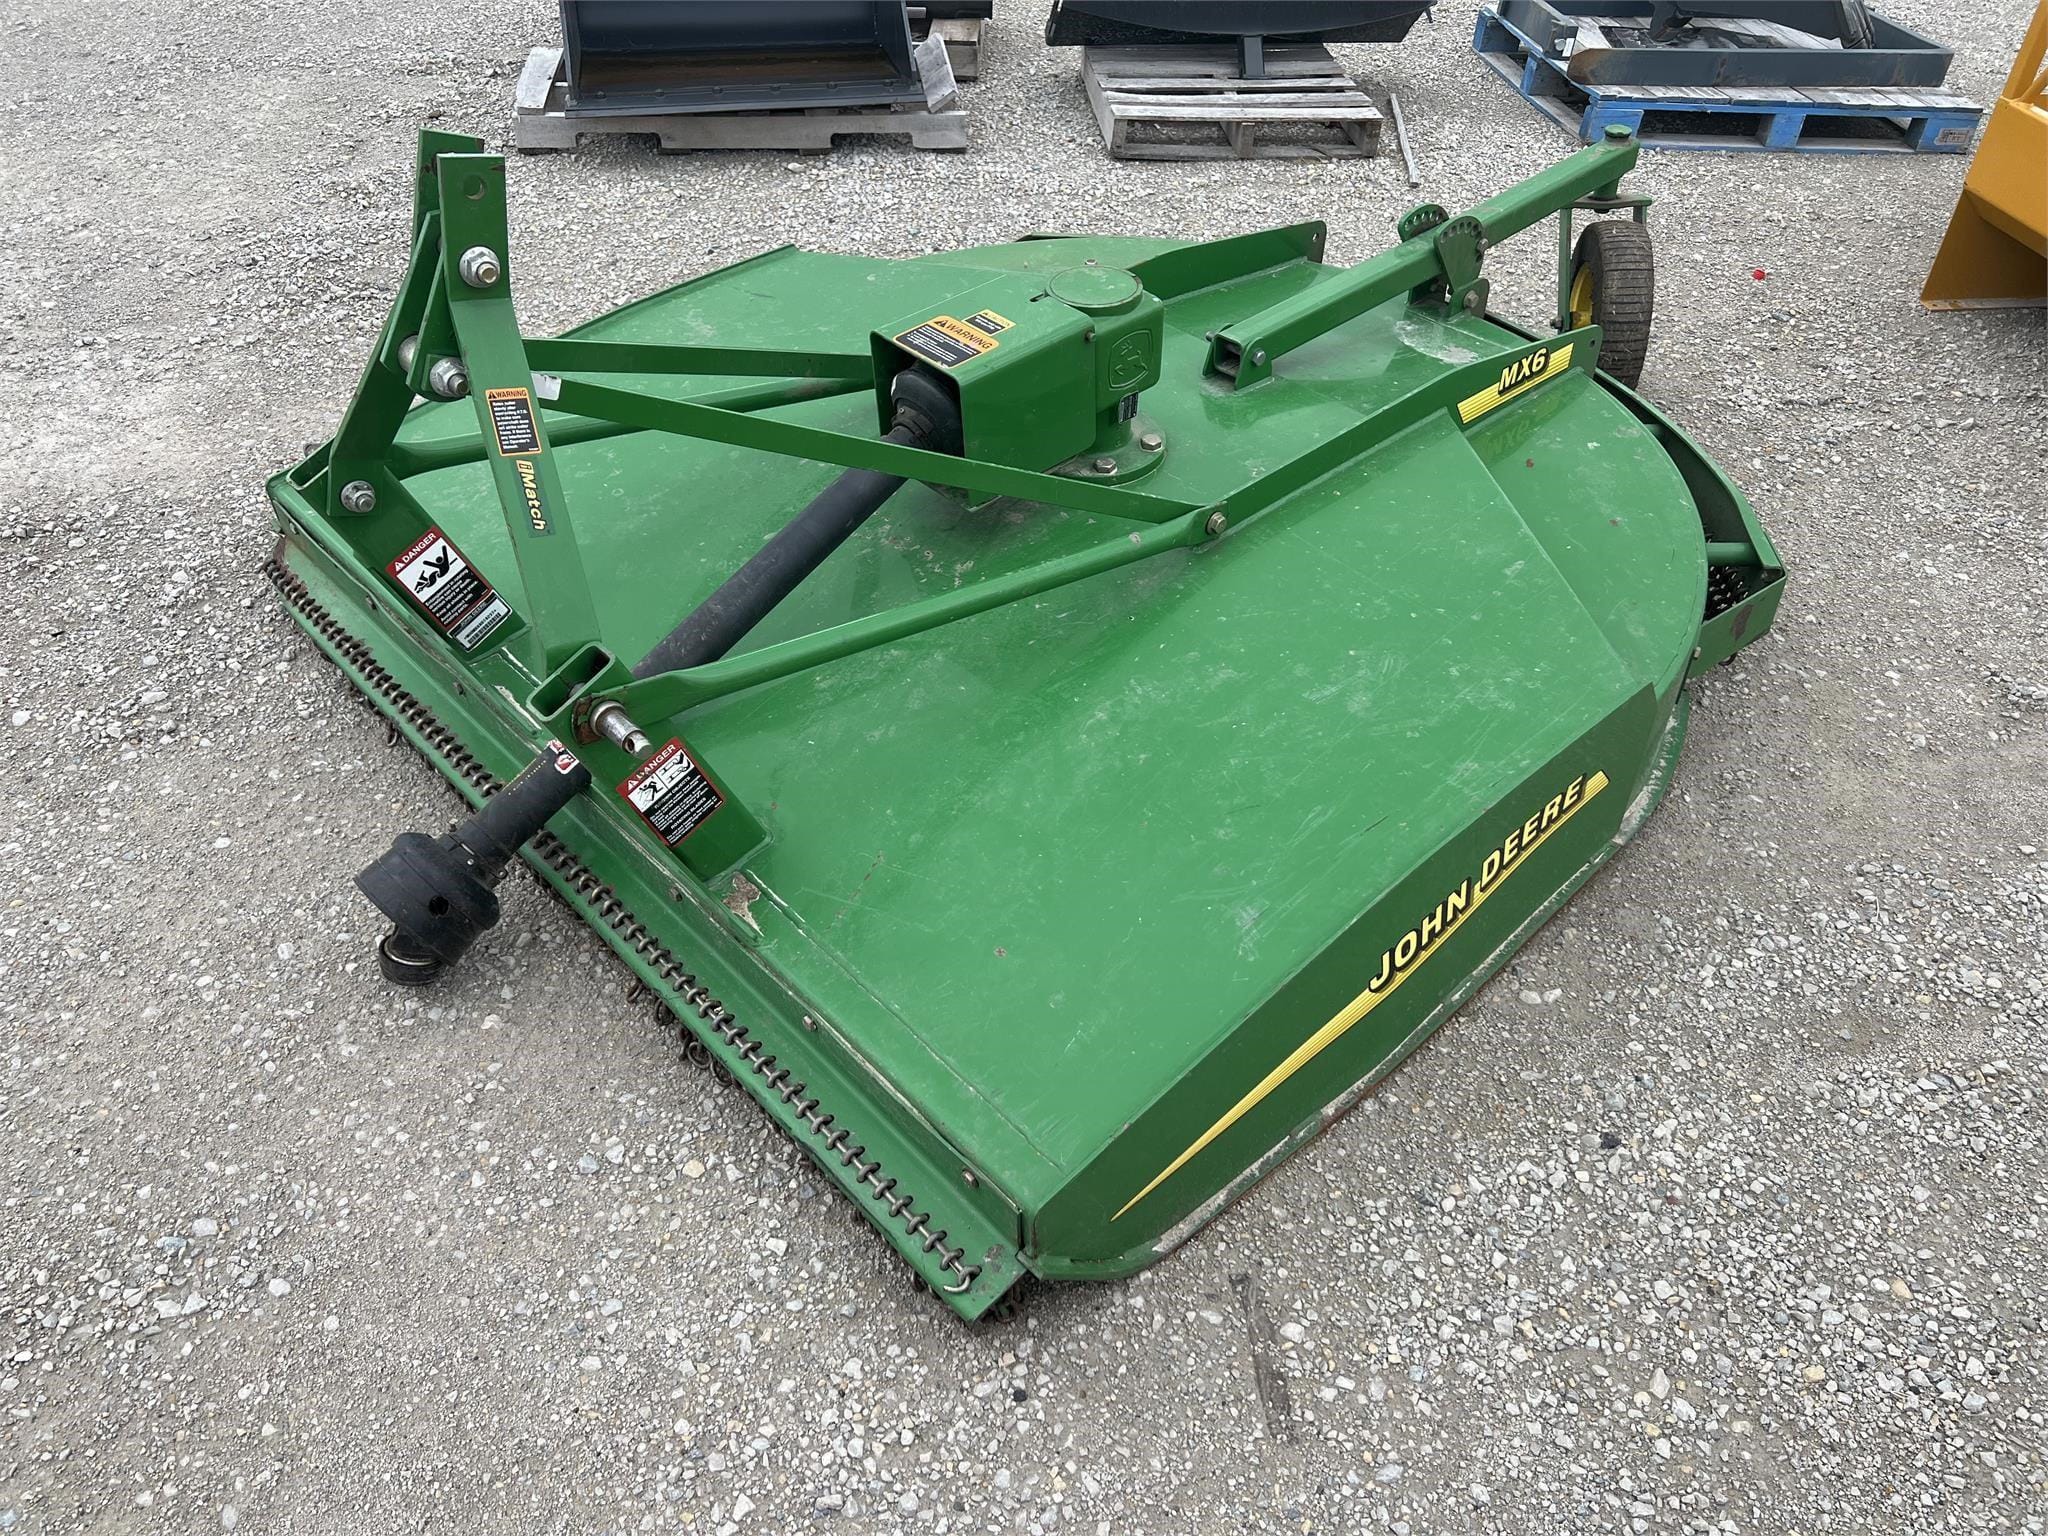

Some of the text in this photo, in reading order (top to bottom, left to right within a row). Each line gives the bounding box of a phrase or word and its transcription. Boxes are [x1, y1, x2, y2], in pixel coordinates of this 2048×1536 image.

[946, 321, 993, 350] WARNING
[1498, 346, 1550, 394] MX6
[496, 390, 527, 398] WARNING
[402, 532, 437, 563] DANGER
[636, 745, 676, 779] DANGER
[1368, 774, 1586, 992] JOHN DEERE
